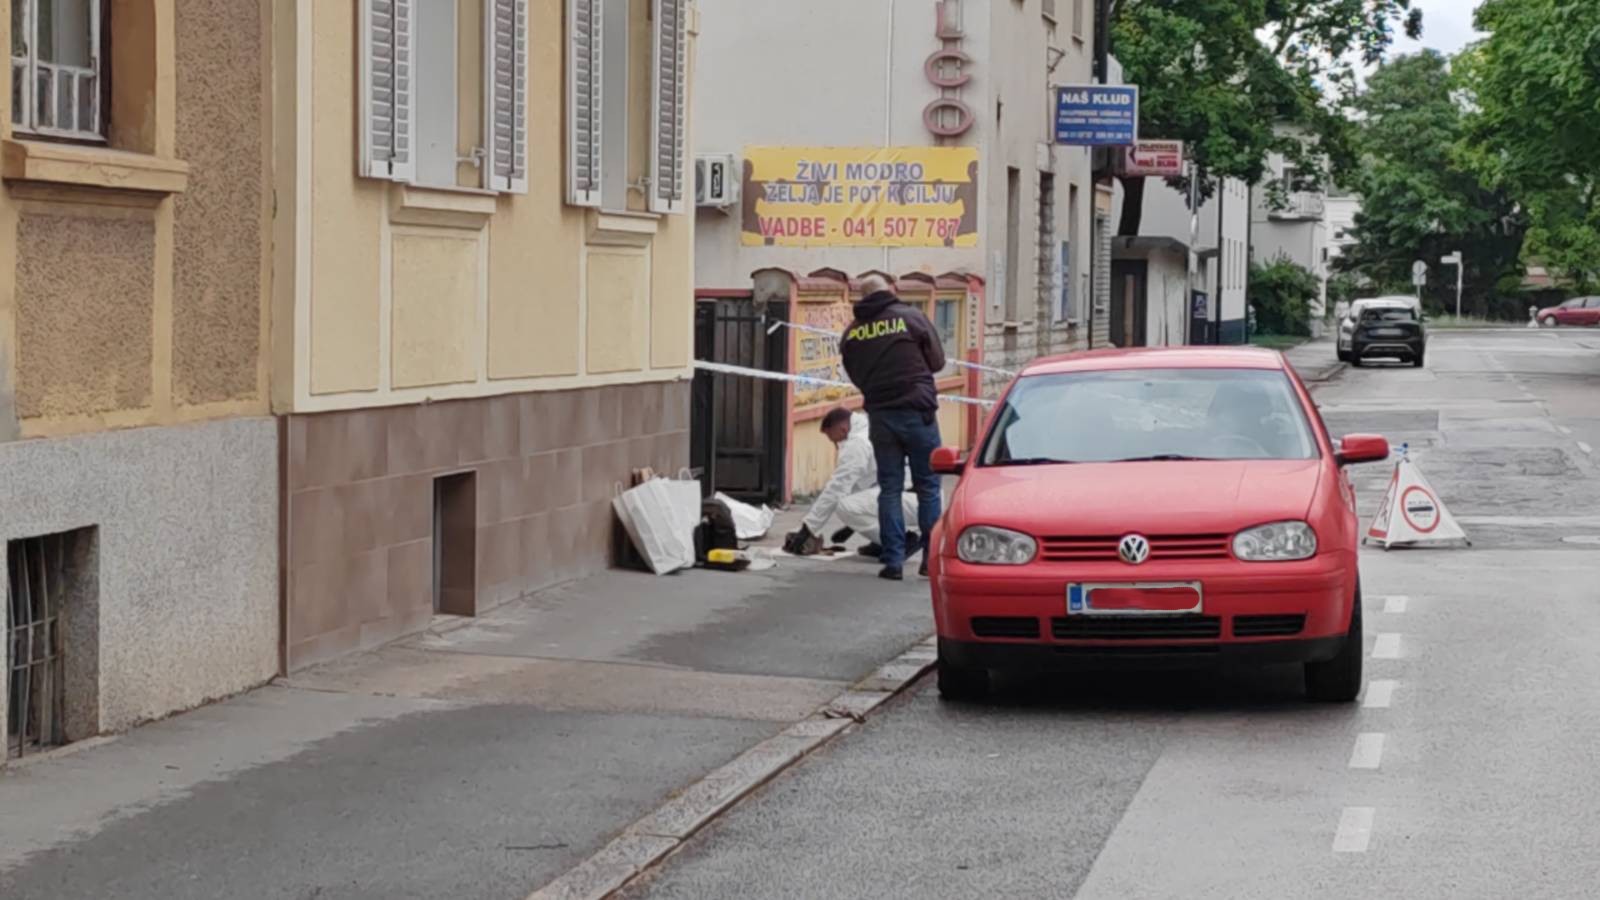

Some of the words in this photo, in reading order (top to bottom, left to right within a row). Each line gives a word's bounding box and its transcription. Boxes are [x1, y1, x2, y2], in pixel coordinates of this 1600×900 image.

[1061, 91, 1089, 104] NAŠ
[1092, 93, 1131, 105] KLUB
[796, 158, 838, 181] ŽIVI
[845, 162, 924, 181] MODRO
[823, 184, 844, 203] JE
[849, 185, 882, 203] POT
[887, 185, 899, 203] K
[904, 185, 956, 204] CILJU
[759, 216, 826, 238] VADBE
[843, 216, 876, 238] 041
[884, 216, 918, 238] 507
[925, 217, 961, 238] 787
